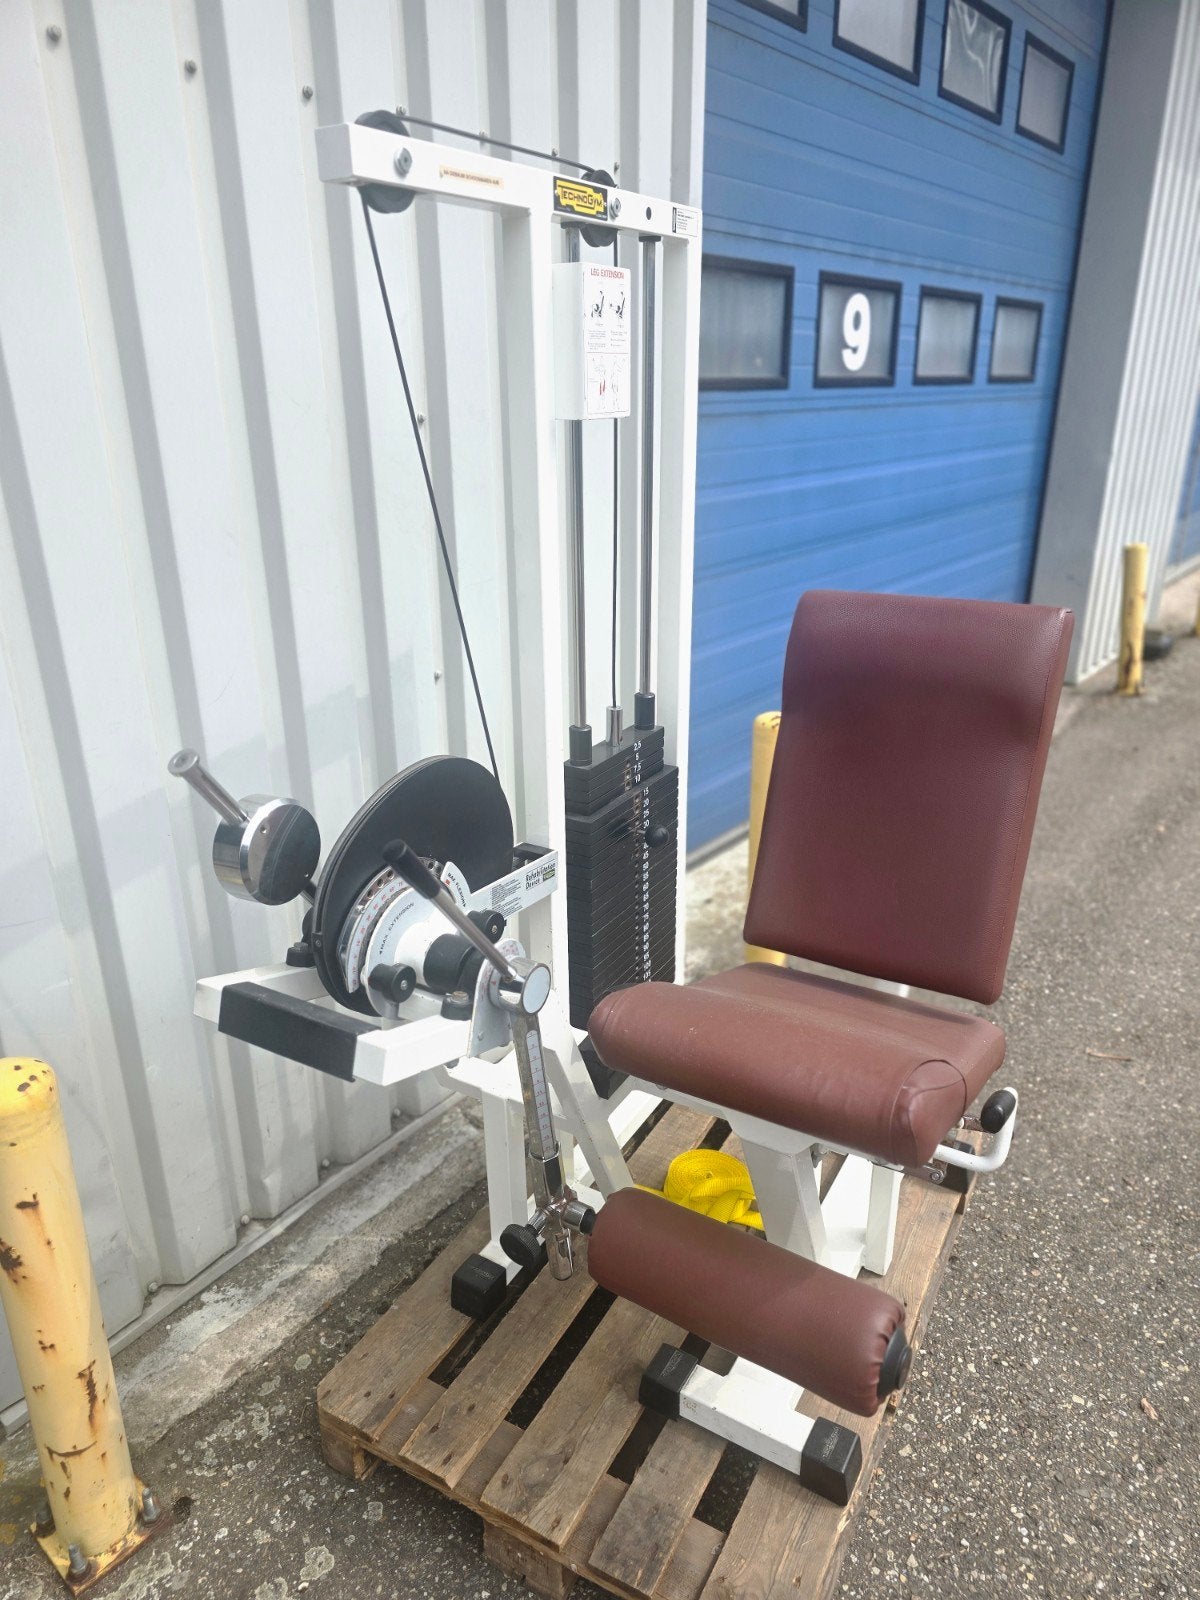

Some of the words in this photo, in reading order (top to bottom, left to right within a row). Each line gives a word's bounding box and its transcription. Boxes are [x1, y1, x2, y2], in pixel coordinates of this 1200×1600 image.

[590, 267, 600, 277] LEG
[600, 269, 625, 279] EXTENSION
[842, 292, 871, 371] 9
[634, 773, 641, 784] 10
[643, 786, 650, 796] 15
